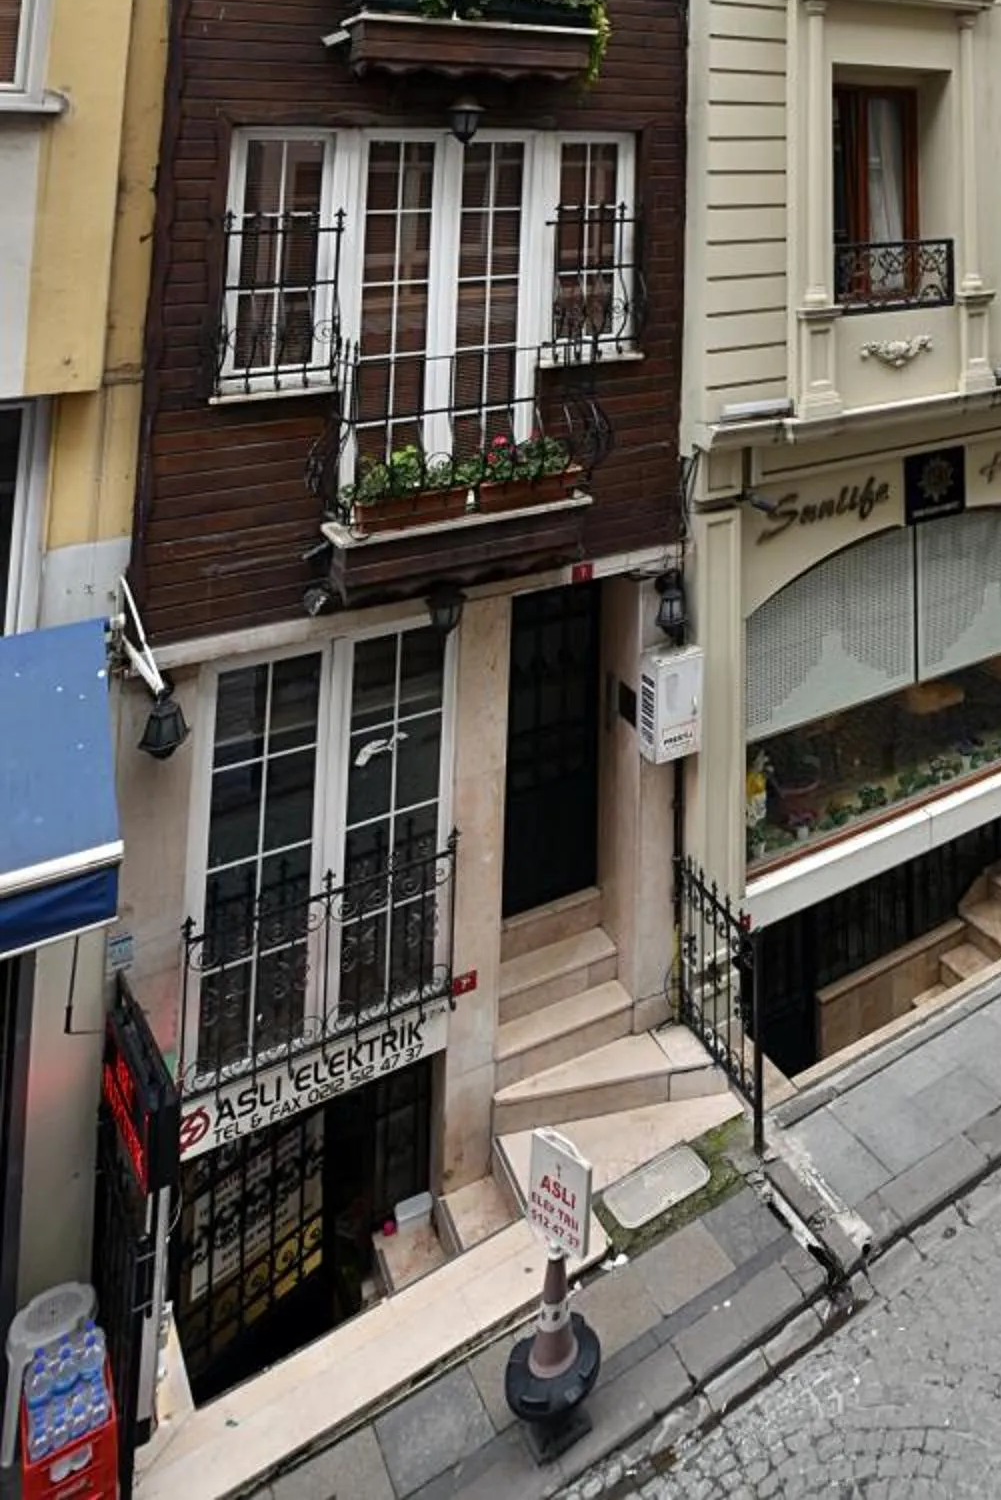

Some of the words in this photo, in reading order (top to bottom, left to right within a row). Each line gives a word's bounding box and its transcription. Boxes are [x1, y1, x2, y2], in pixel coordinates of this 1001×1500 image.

[756, 475, 890, 546] Sunlife
[213, 1075, 282, 1127] ASLI
[294, 1018, 424, 1092] ELEKTRİK
[213, 1122, 241, 1144] TEL
[251, 1113, 262, 1129] &
[269, 1095, 301, 1122] FAX
[308, 1077, 345, 1103] 0212
[350, 1067, 374, 1088] 512
[380, 1053, 399, 1072] 47
[405, 1043, 424, 1063] 37
[541, 1174, 576, 1210] ASLI
